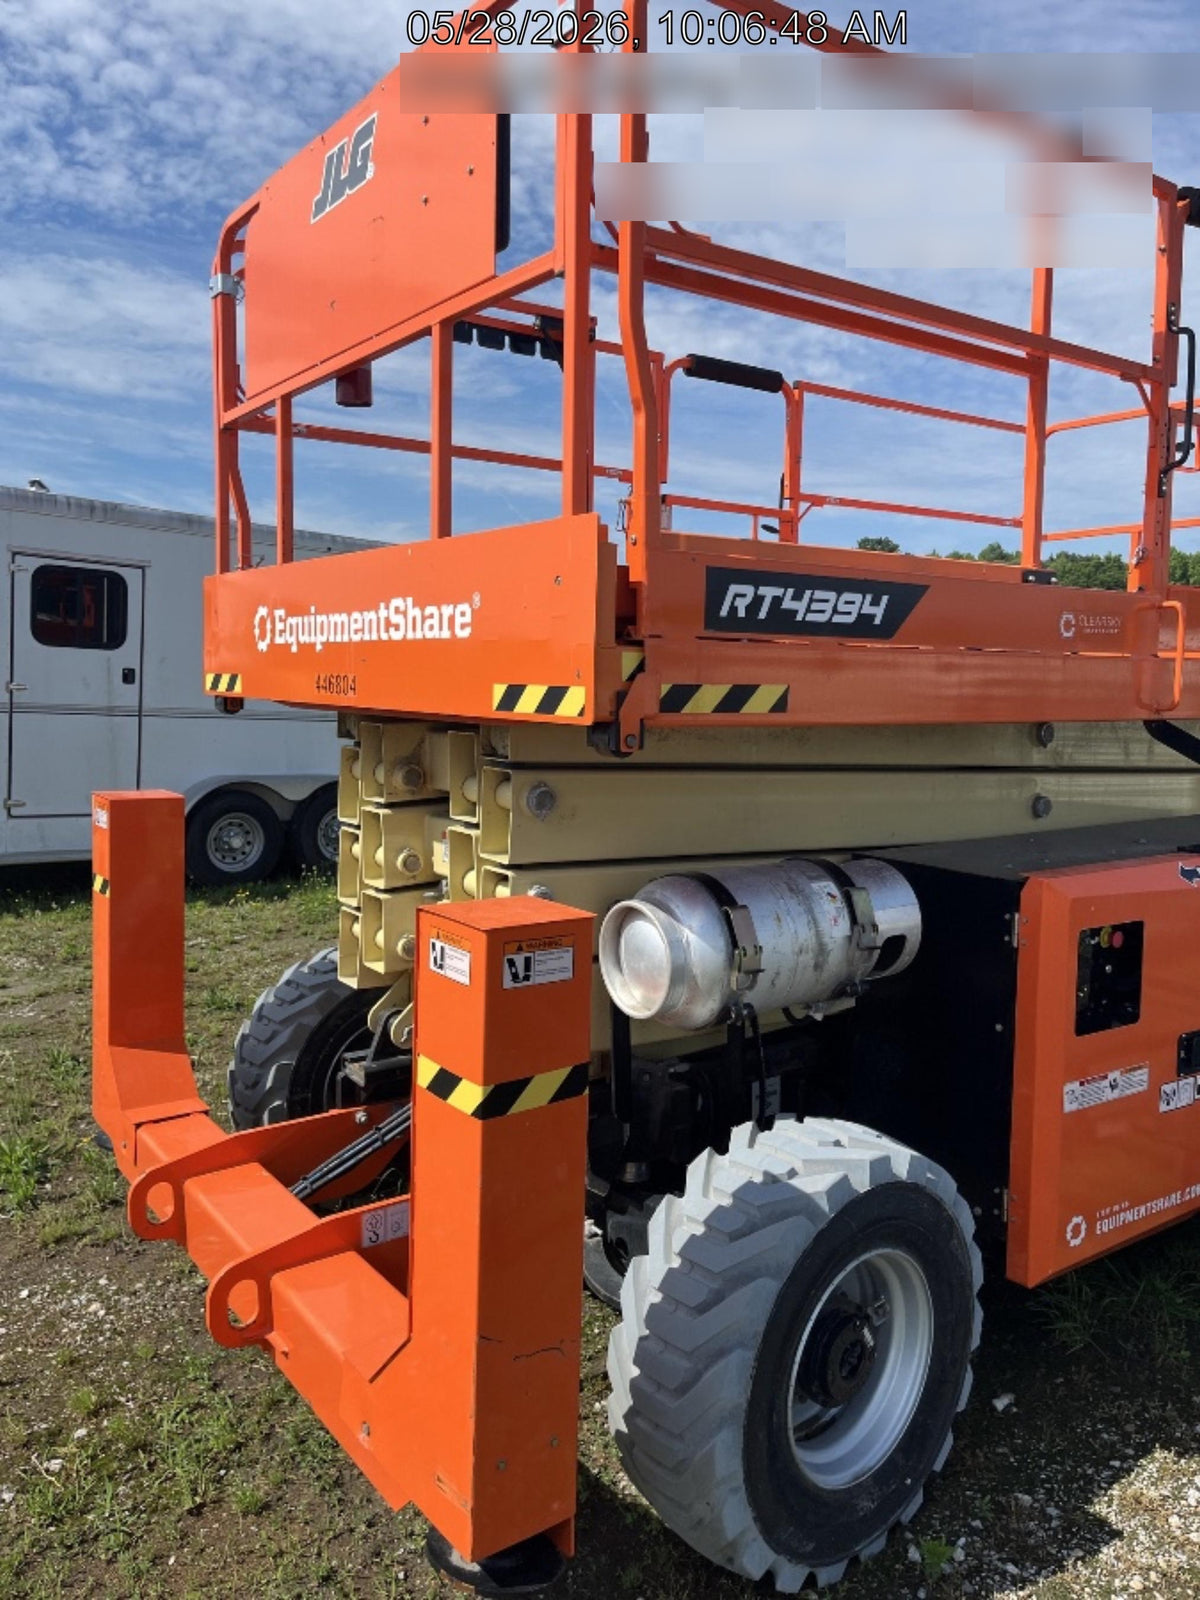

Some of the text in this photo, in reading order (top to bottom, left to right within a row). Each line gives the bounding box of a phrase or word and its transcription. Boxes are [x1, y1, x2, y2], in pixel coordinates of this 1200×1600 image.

[310, 111, 378, 225] JLG
[719, 583, 890, 625] RT4394
[315, 673, 357, 696] 446804
